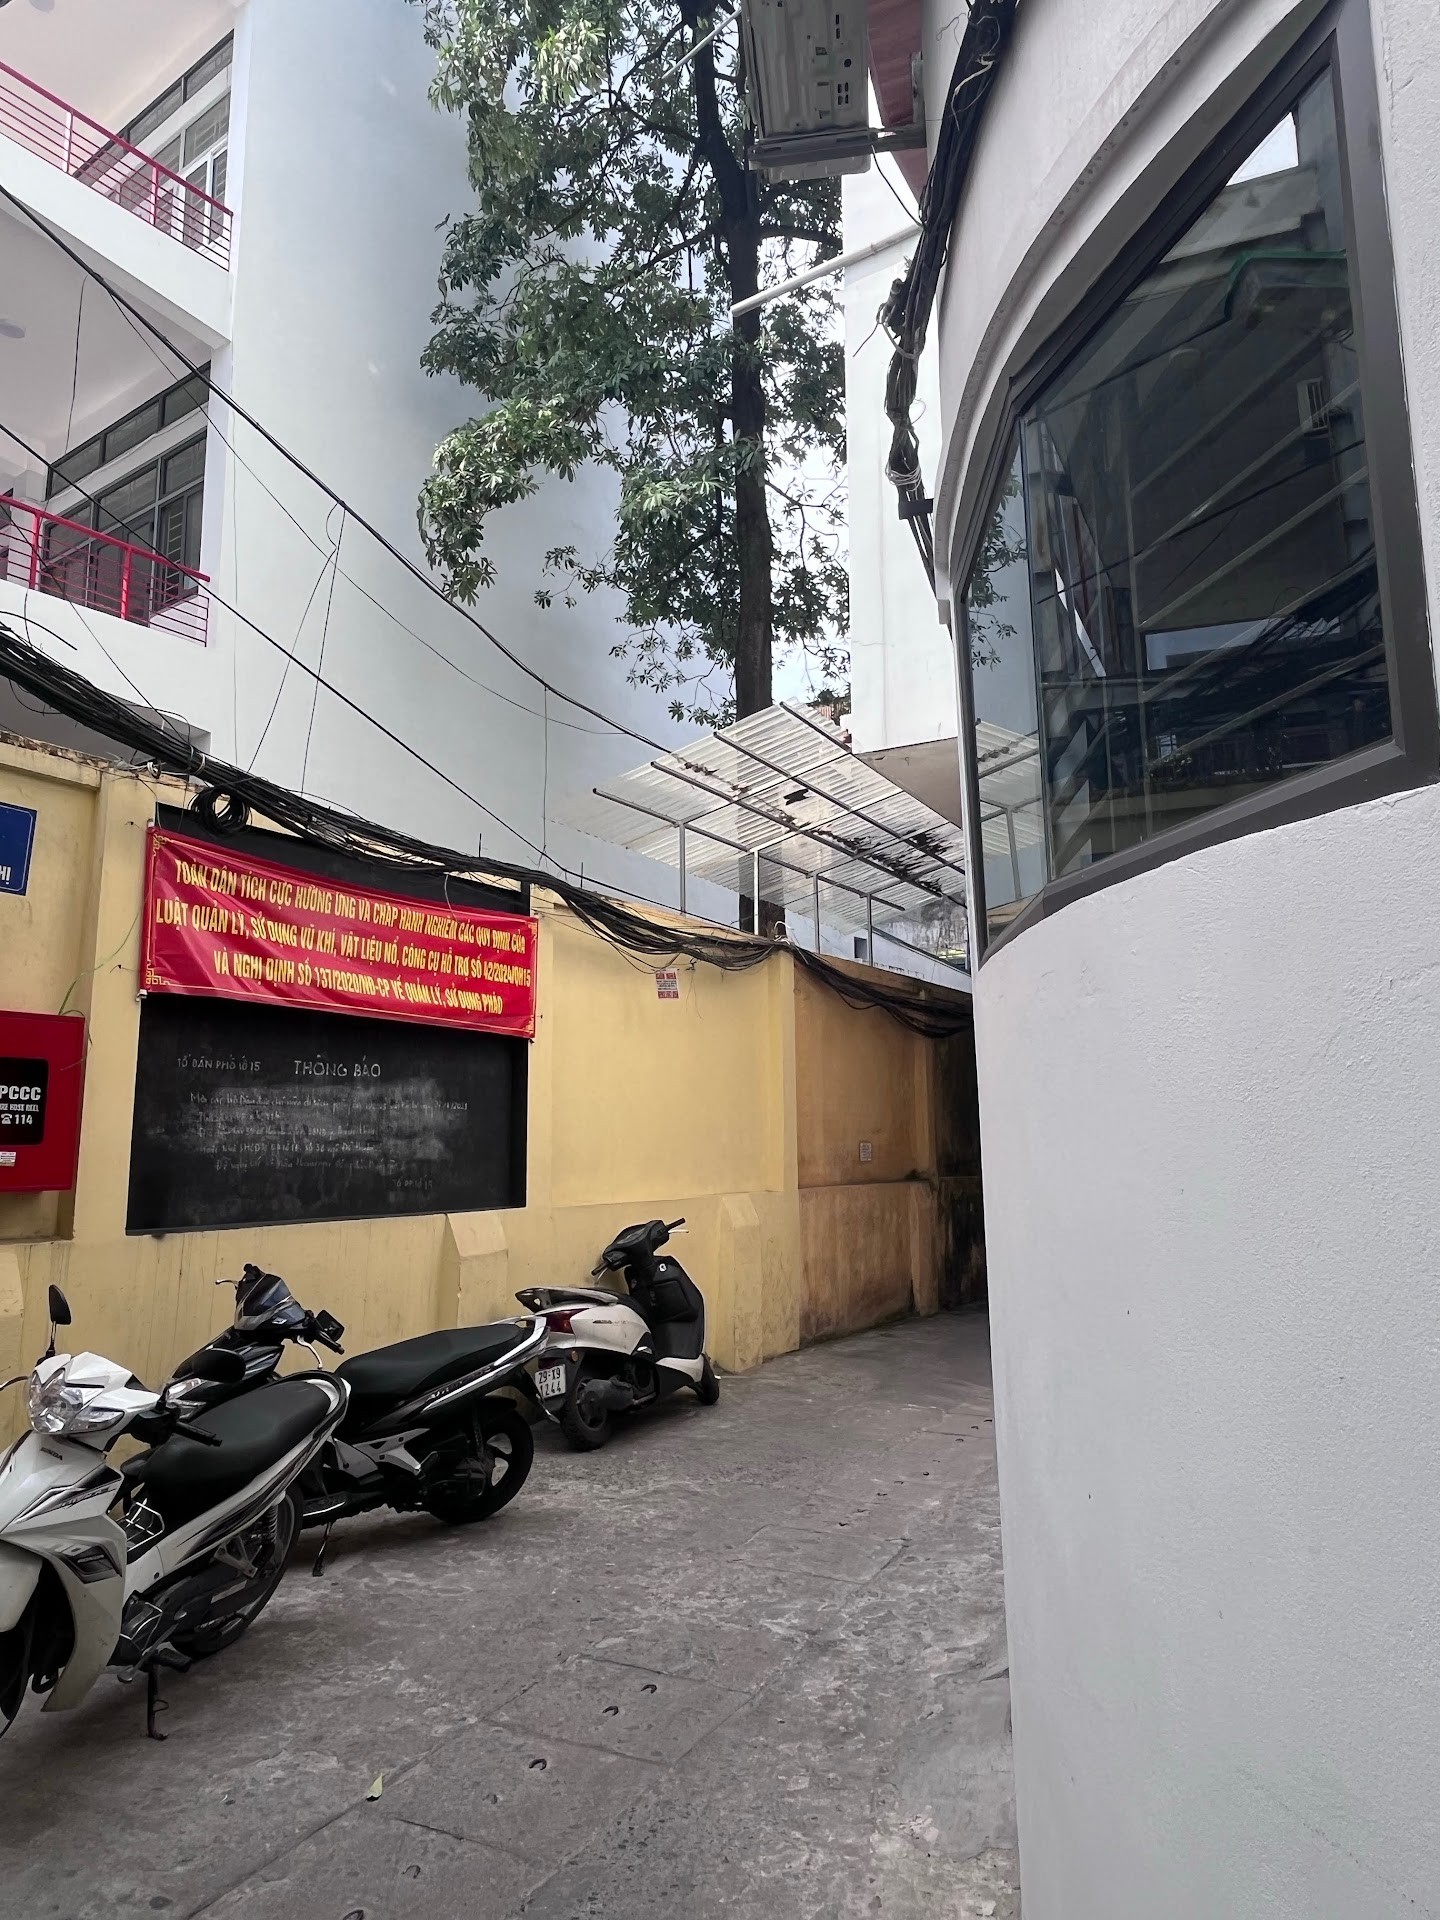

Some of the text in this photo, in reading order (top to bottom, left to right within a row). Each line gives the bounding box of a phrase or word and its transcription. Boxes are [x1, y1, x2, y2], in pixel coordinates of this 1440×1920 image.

[210, 864, 237, 895] DÂN
[240, 871, 267, 901] TÍCH
[270, 880, 292, 910] CỰC
[358, 898, 370, 922] VÀ
[399, 907, 424, 933] HÀNH
[424, 915, 457, 940] NGHIÊM
[458, 919, 474, 943] CÁC
[476, 926, 490, 947] QUY
[492, 930, 510, 953] ĐỊNH
[511, 929, 525, 954] CỦA
[156, 896, 188, 930] LUẬT
[192, 899, 228, 933] QUẢN
[231, 909, 249, 939] LÝ,
[250, 911, 266, 939] SỬ
[267, 920, 297, 948] DỤNG
[300, 923, 315, 951] VŨ
[316, 927, 337, 957] KHÍ,
[341, 930, 359, 961] VẬT
[361, 935, 382, 965] LIỆU
[384, 936, 399, 968] NỔ,
[402, 942, 427, 969] CÔNG
[428, 951, 440, 976] CỤ
[440, 947, 453, 973] HỖ
[454, 955, 469, 981] TRỢ
[470, 954, 482, 978] SỐ
[213, 947, 230, 975] VÀ
[233, 953, 262, 985] NGHỊ
[265, 958, 295, 987] ĐỊNH
[297, 957, 312, 986] SỐ
[404, 977, 431, 1003] QUẢN
[445, 982, 459, 1008] SỬ
[458, 990, 482, 1014] DỤNG
[481, 991, 503, 1014] PHÁO
[250, 1061, 261, 1071] 15
[294, 1054, 381, 1077] THÔNG BÁO
[0, 1085, 41, 1101] PCCC
[15, 1114, 33, 1125] 114
